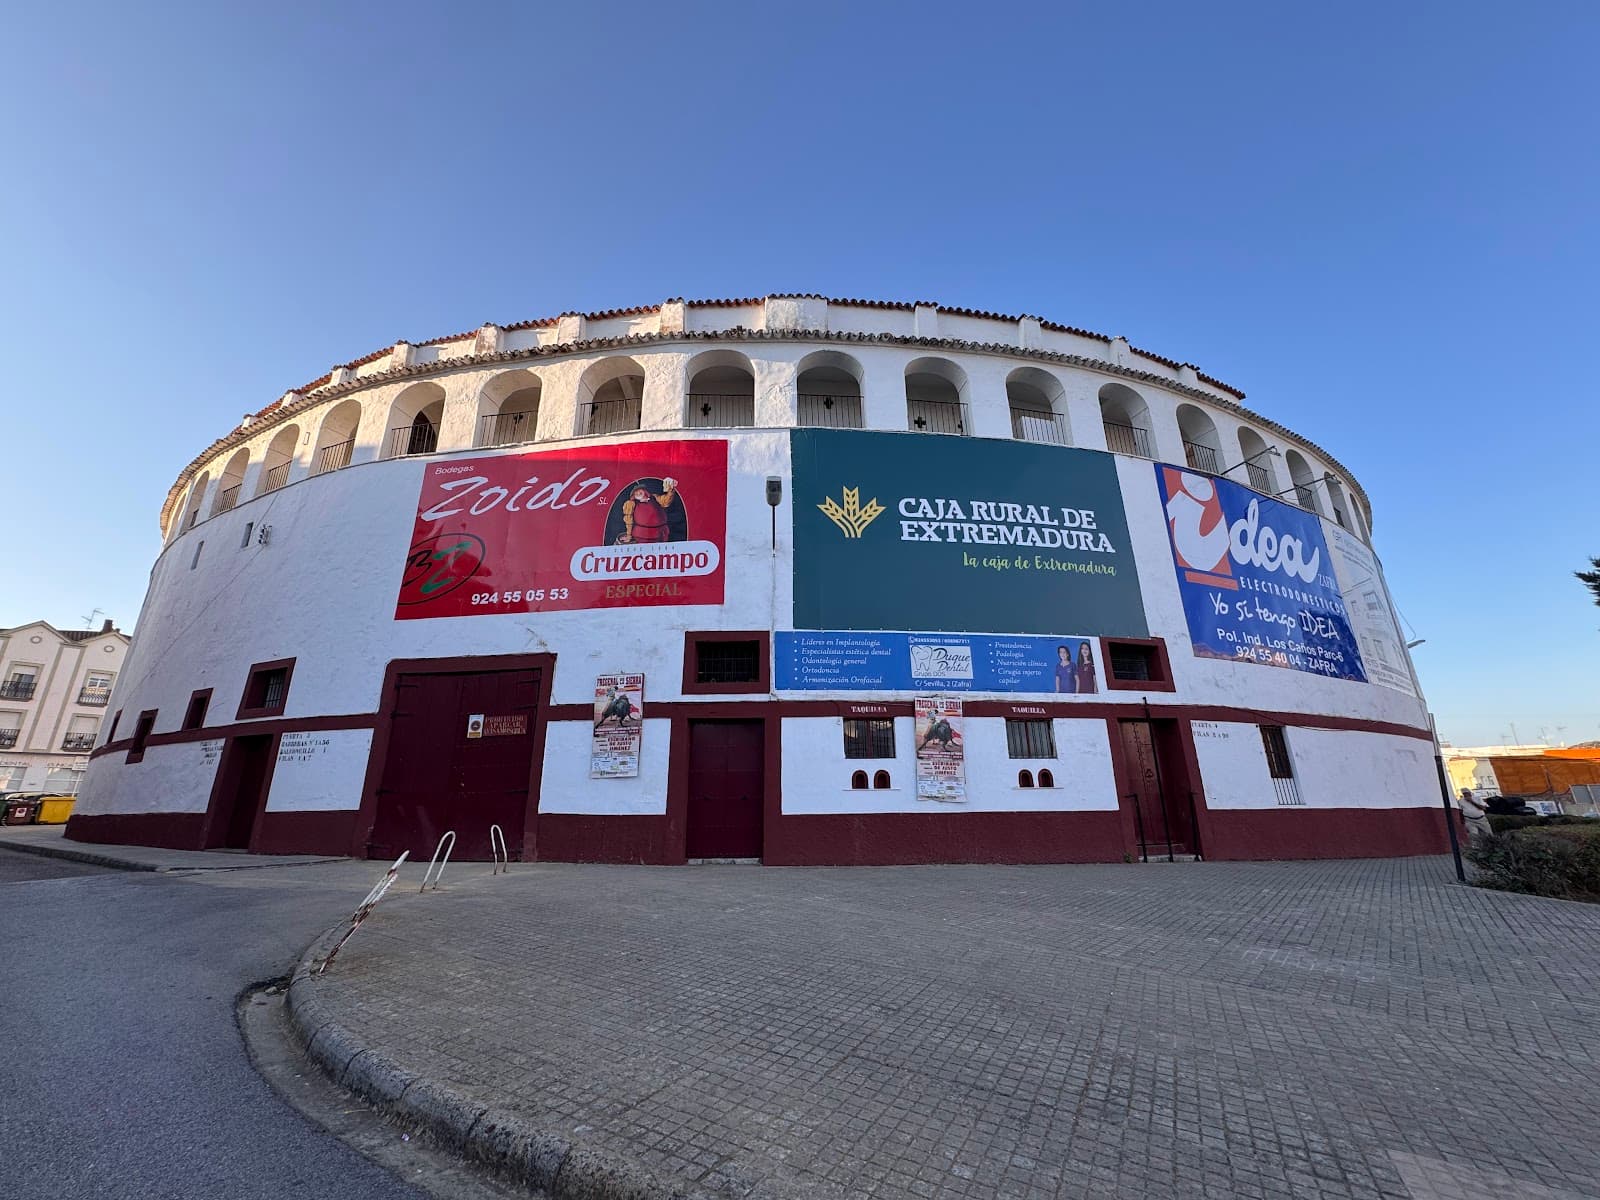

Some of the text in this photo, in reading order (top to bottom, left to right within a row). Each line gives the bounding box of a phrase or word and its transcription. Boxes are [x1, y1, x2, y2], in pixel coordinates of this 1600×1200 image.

[434, 465, 475, 475] Bodegas
[421, 467, 610, 522] Zoido
[899, 498, 1097, 529] CAJA RURAL DE
[900, 521, 1116, 553] EXTREMADURA
[580, 551, 709, 574] Cruzcampo
[963, 552, 1117, 577] La caja de Extremadura
[471, 588, 569, 605] 924 55 05 53
[606, 583, 682, 599] ESPECIAL
[1209, 592, 1229, 615] Yo
[1255, 597, 1296, 636] tengo
[1298, 609, 1341, 640] IDEA
[801, 638, 825, 646] Líderes
[835, 638, 881, 647] Implantología
[1216, 628, 1241, 643] Pol.
[1243, 631, 1265, 646] Ind.
[1266, 636, 1286, 650] Los
[1288, 640, 1316, 656] Caños
[801, 647, 844, 656] Especialistas
[870, 648, 892, 656] dental
[933, 648, 971, 666] Duque
[1236, 645, 1257, 660] 924
[1259, 649, 1272, 662] 55
[1274, 652, 1288, 664] 40
[1289, 654, 1301, 666] 04
[1307, 657, 1337, 673] ZAFRA
[801, 666, 840, 674] Ortodoncia
[843, 657, 867, 665] general
[850, 675, 882, 684] Orofacial
